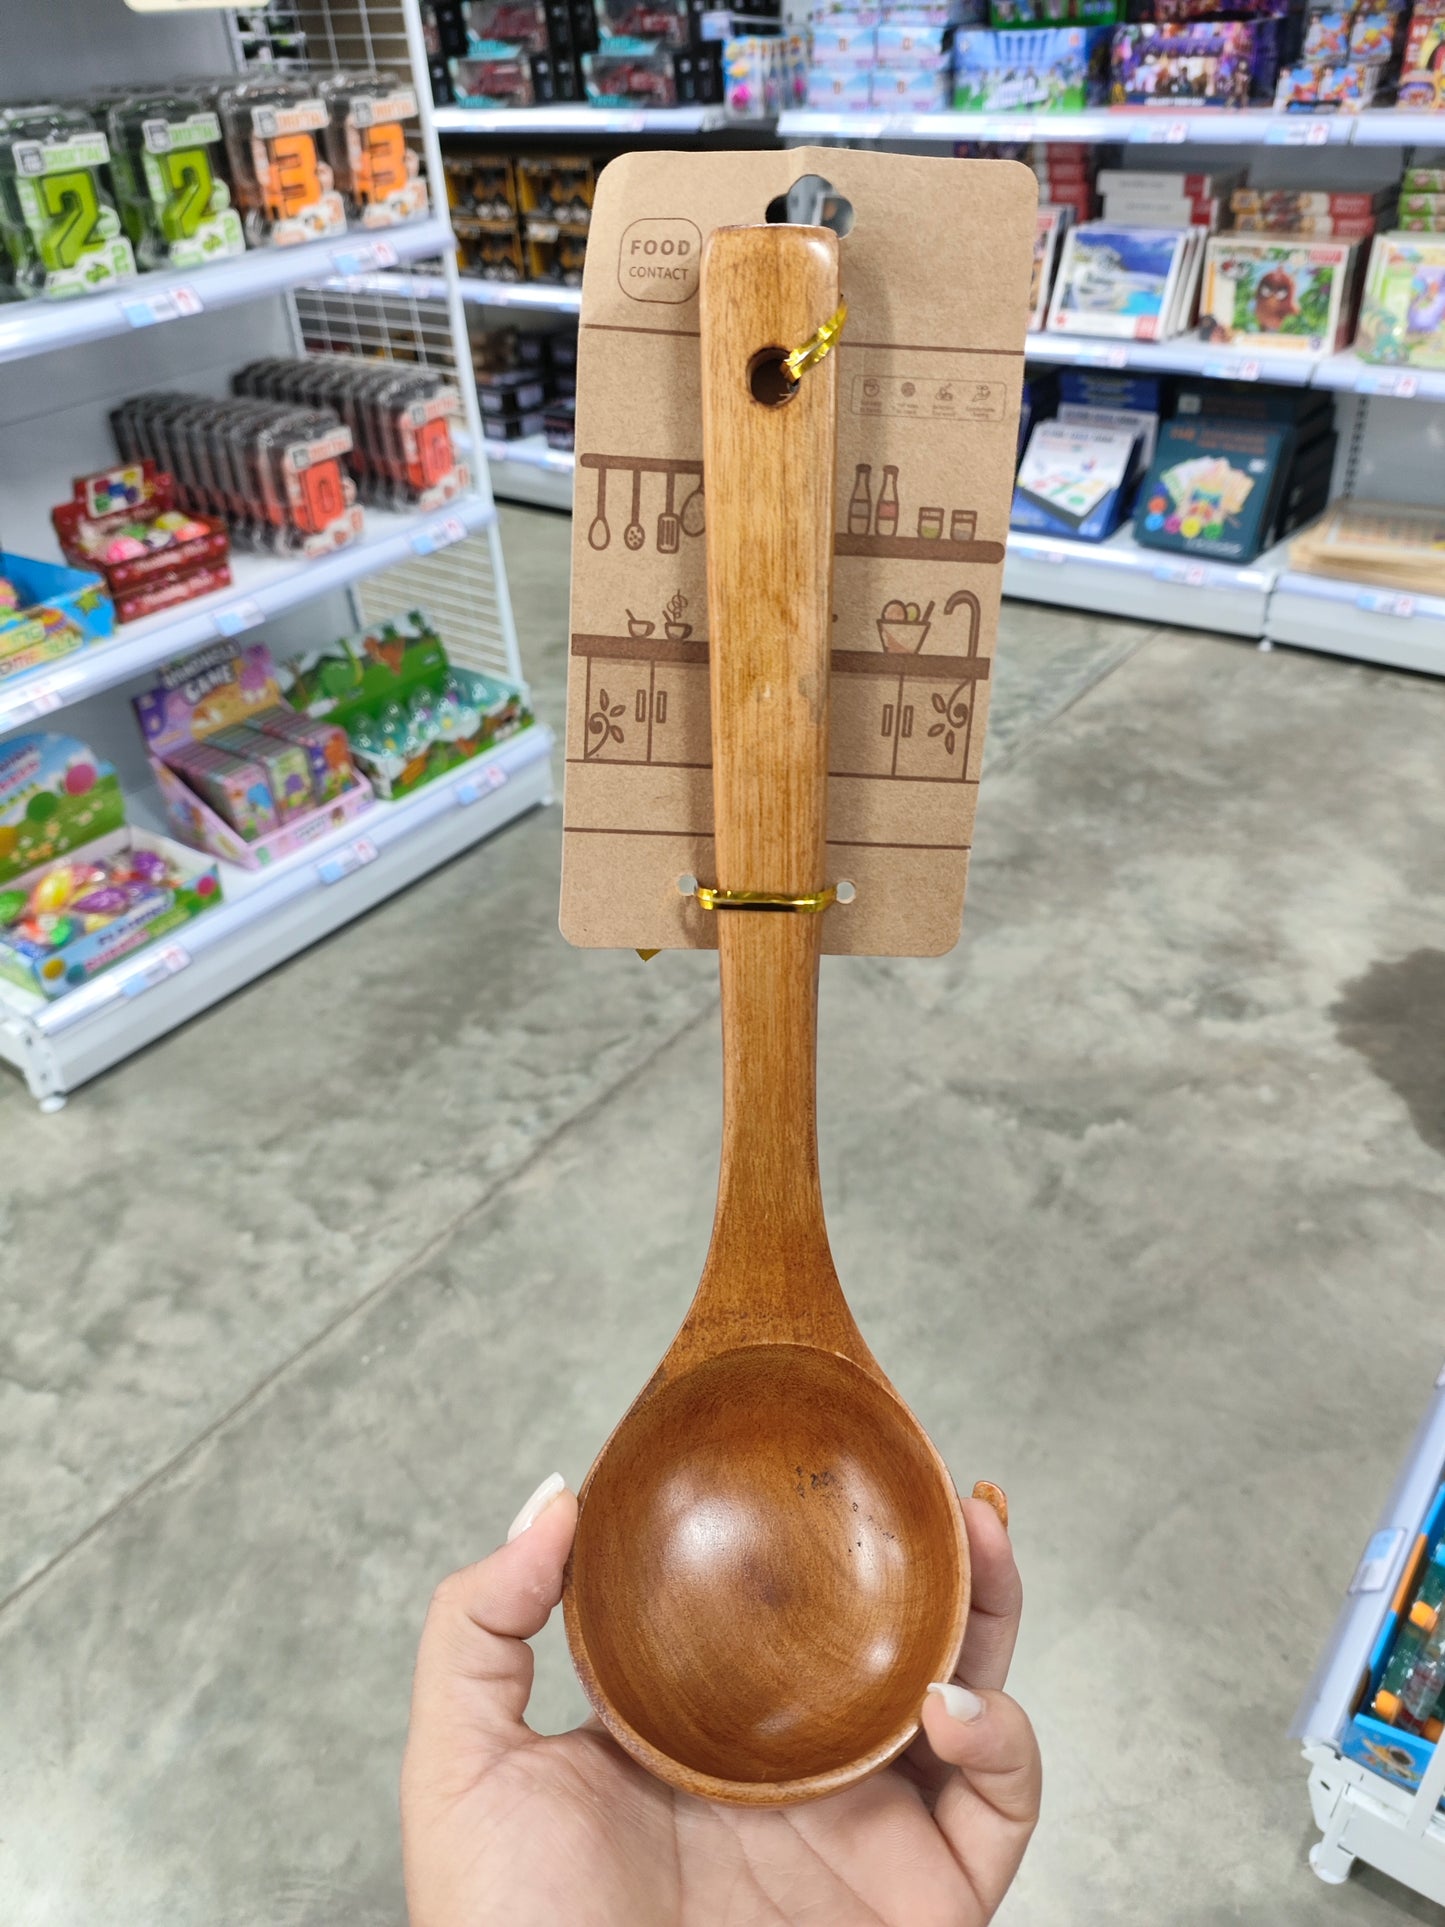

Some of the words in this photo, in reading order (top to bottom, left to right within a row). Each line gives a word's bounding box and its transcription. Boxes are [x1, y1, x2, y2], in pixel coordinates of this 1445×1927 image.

[40, 168, 106, 272] 2
[162, 149, 217, 242] 2
[628, 266, 689, 281] CONTACT
[630, 239, 691, 256] FOOD
